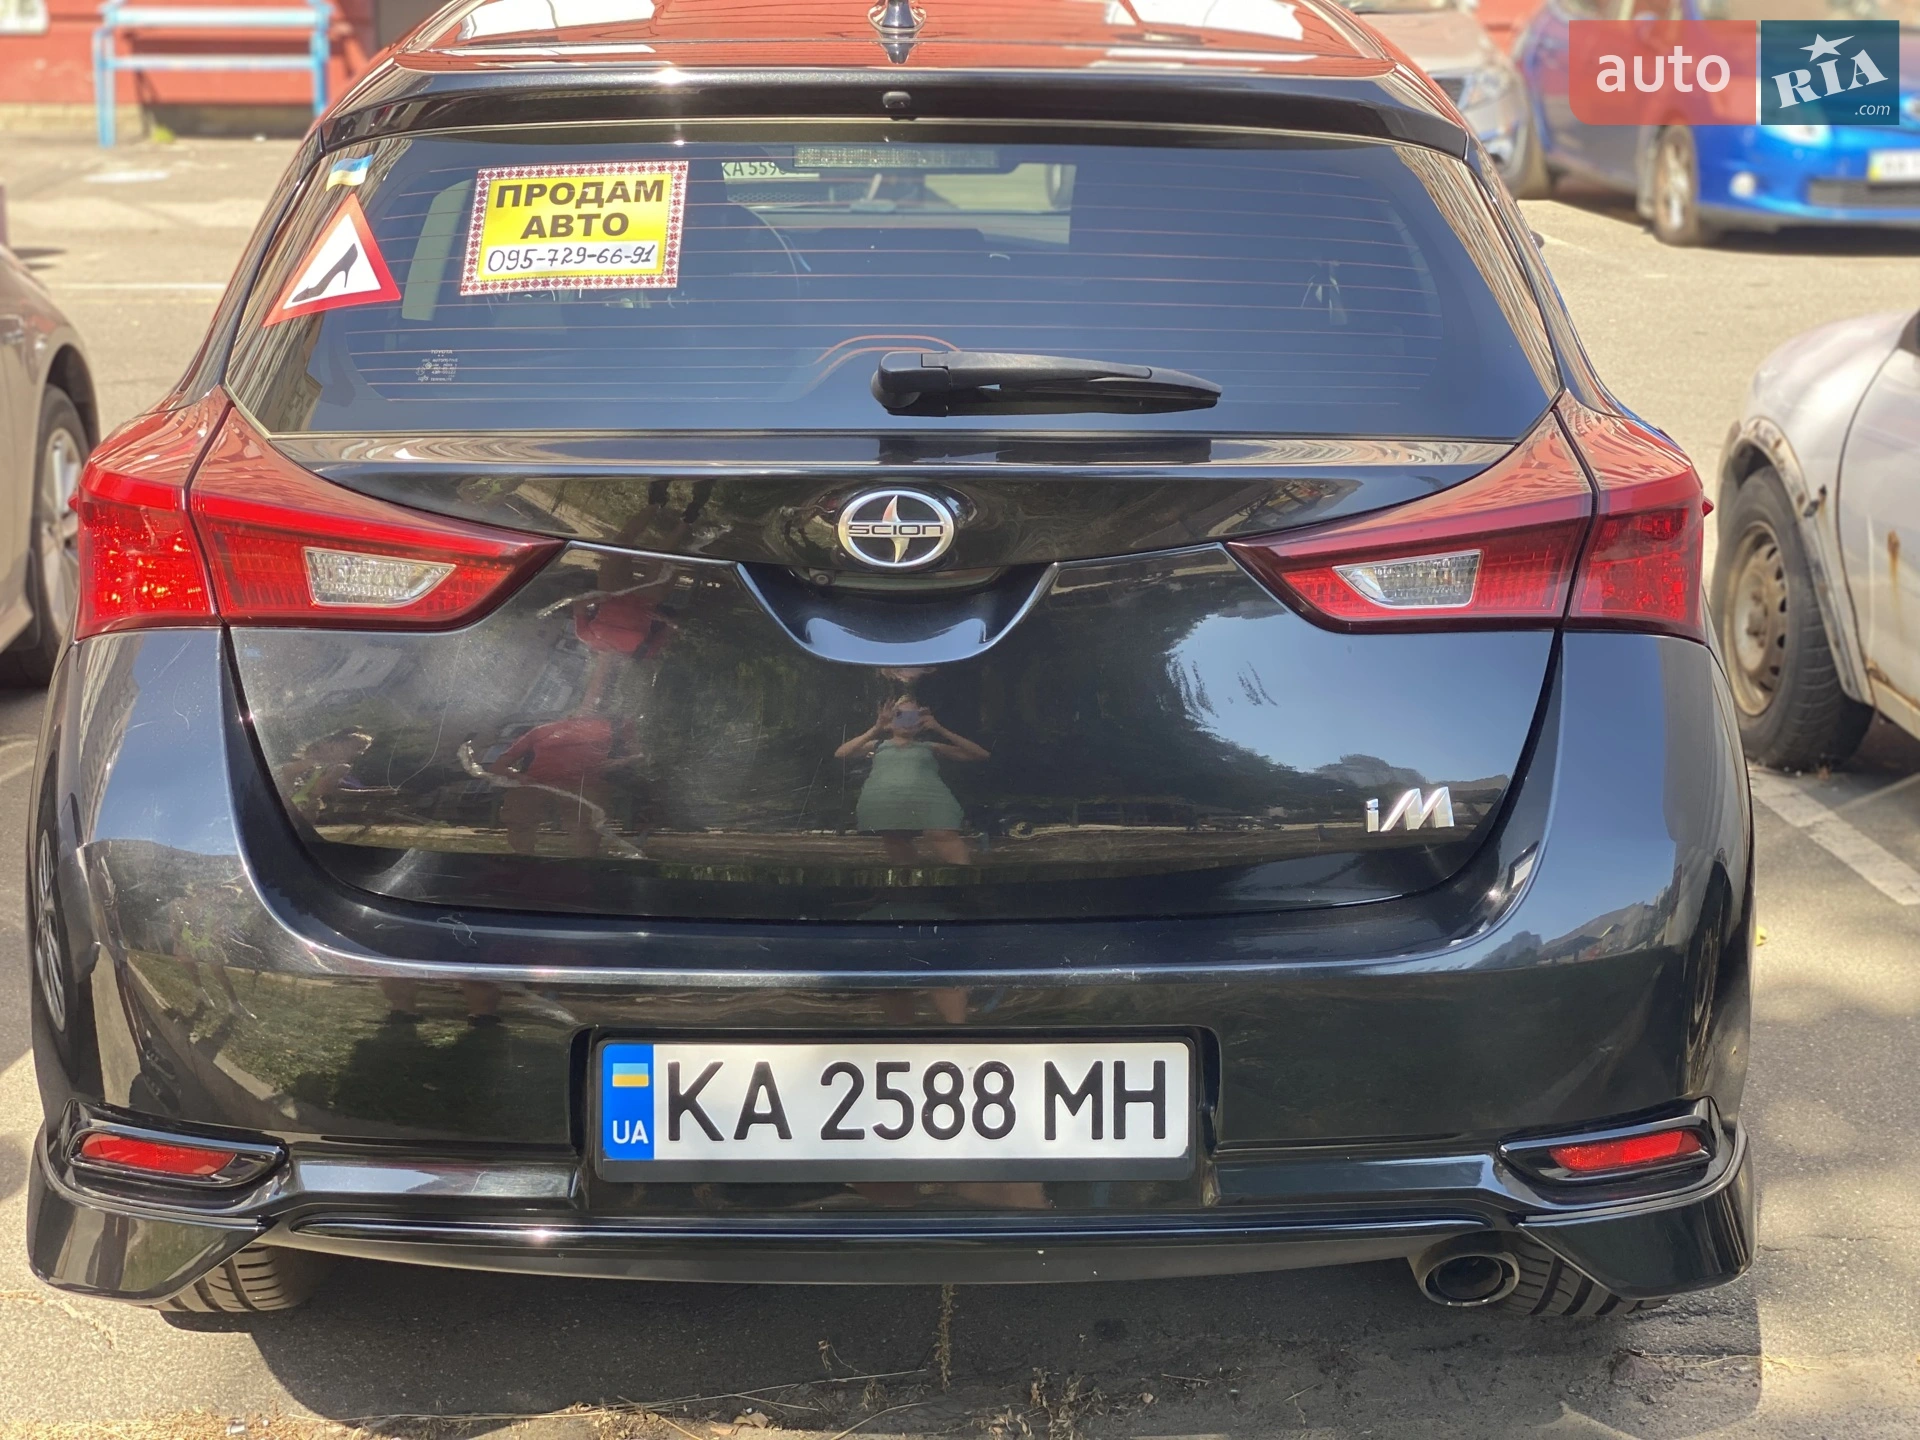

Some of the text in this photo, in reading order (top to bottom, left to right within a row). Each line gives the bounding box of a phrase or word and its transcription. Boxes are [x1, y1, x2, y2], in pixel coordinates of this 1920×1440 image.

[496, 179, 665, 209] ПРОДАМ
[520, 212, 629, 239] АВТО
[487, 244, 656, 272] 095-729-66-91
[848, 524, 944, 535] SCION
[1366, 786, 1454, 833] iM
[667, 1060, 1166, 1141] KA 2588 MH
[612, 1121, 649, 1144] UA
